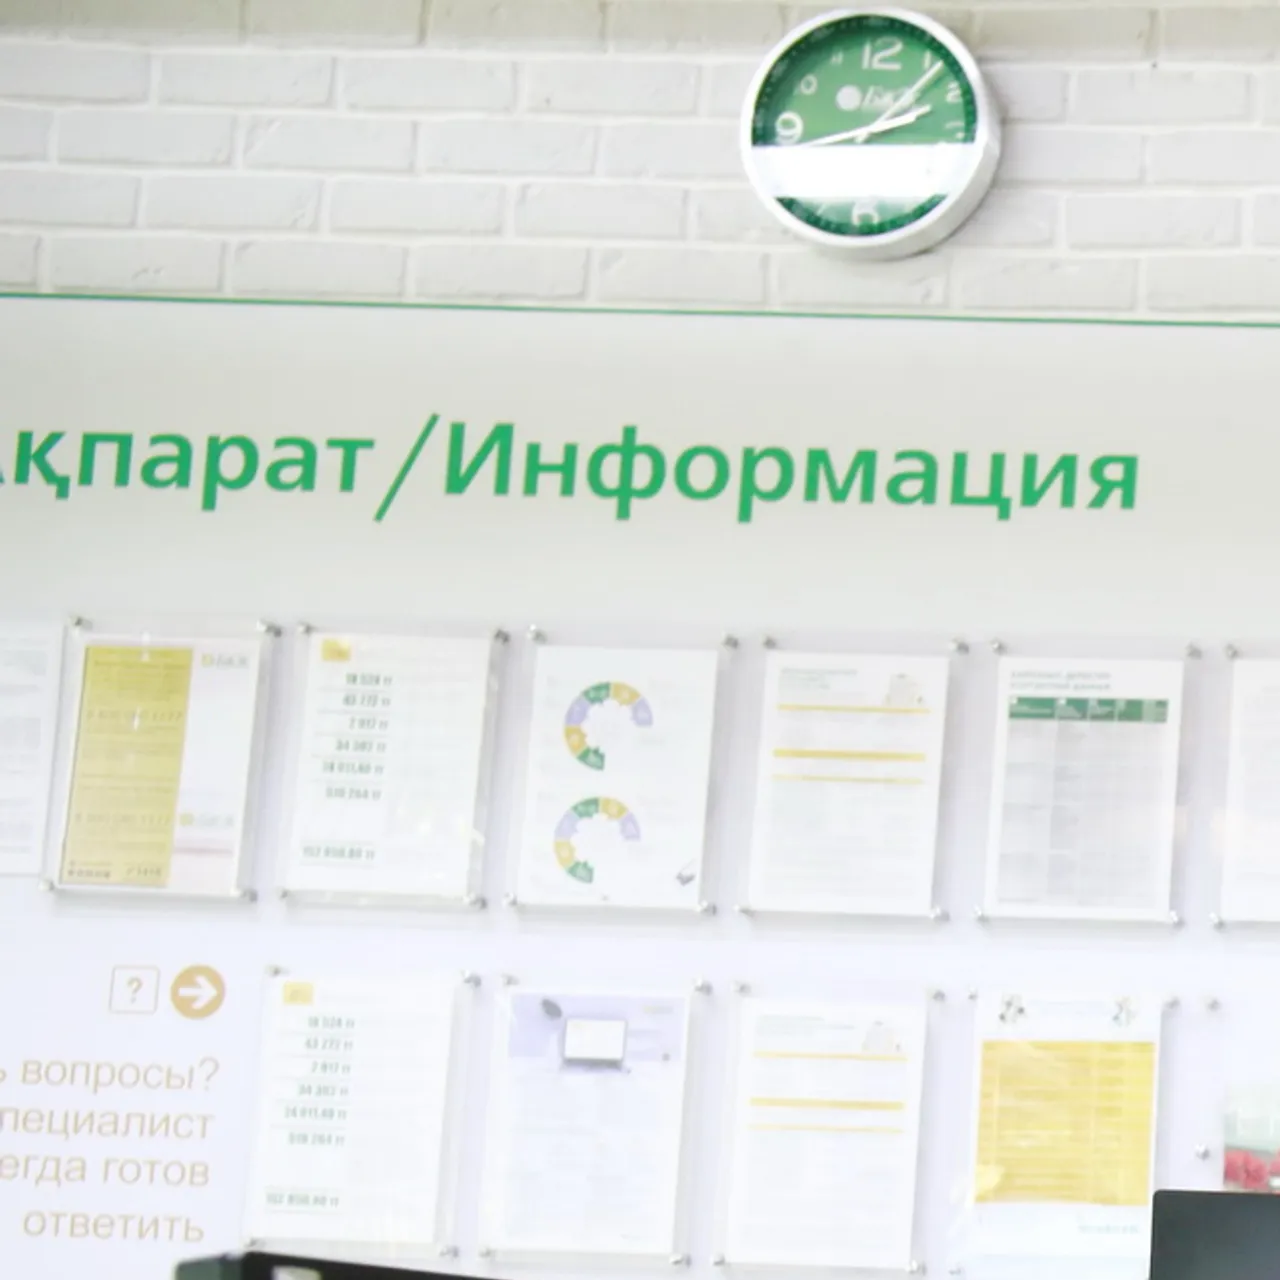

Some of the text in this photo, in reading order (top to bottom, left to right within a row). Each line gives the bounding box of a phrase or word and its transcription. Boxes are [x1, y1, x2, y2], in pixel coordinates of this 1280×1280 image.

[862, 36, 903, 70] 12
[21, 1056, 220, 1095] вопросы?
[103, 1157, 210, 1187] готов
[23, 1210, 205, 1242] ответить
